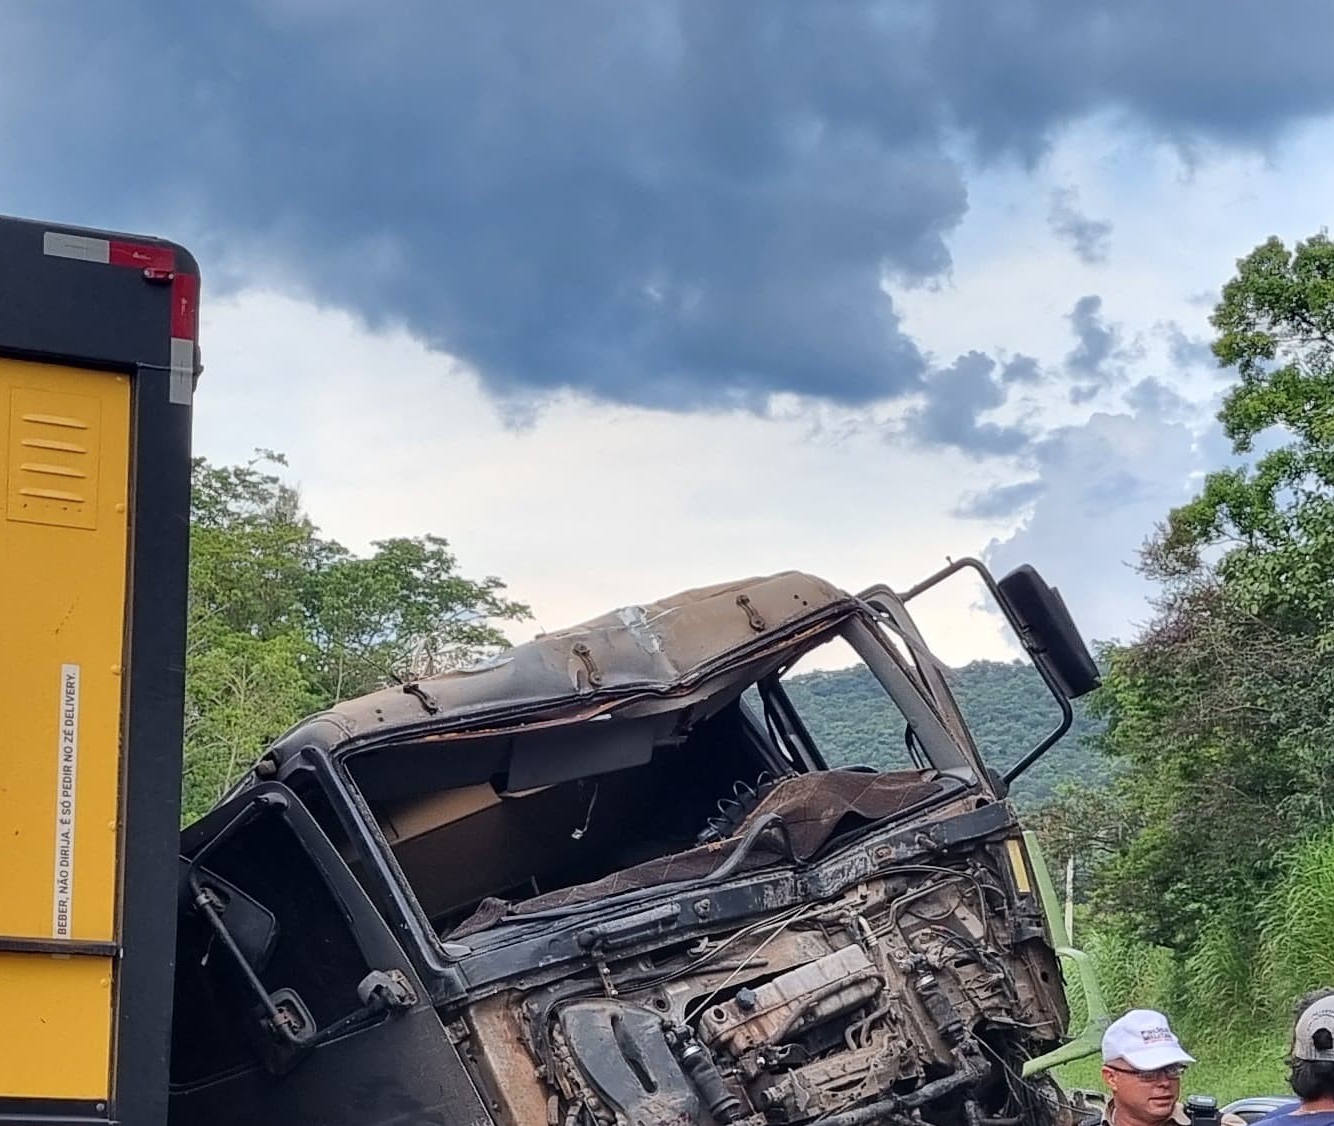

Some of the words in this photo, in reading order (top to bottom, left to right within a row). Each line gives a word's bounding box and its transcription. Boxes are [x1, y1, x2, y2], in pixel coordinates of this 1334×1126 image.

[63, 672, 76, 727] DELIVERY.
[62, 729, 74, 744] ZÉ
[63, 745, 74, 763] NO
[62, 765, 73, 798] PEDIR
[60, 800, 72, 816] SÓ
[60, 817, 71, 826] É
[60, 828, 71, 868] DIRIJA.
[58, 869, 69, 895] NÃO
[57, 897, 70, 935] BEBER,
